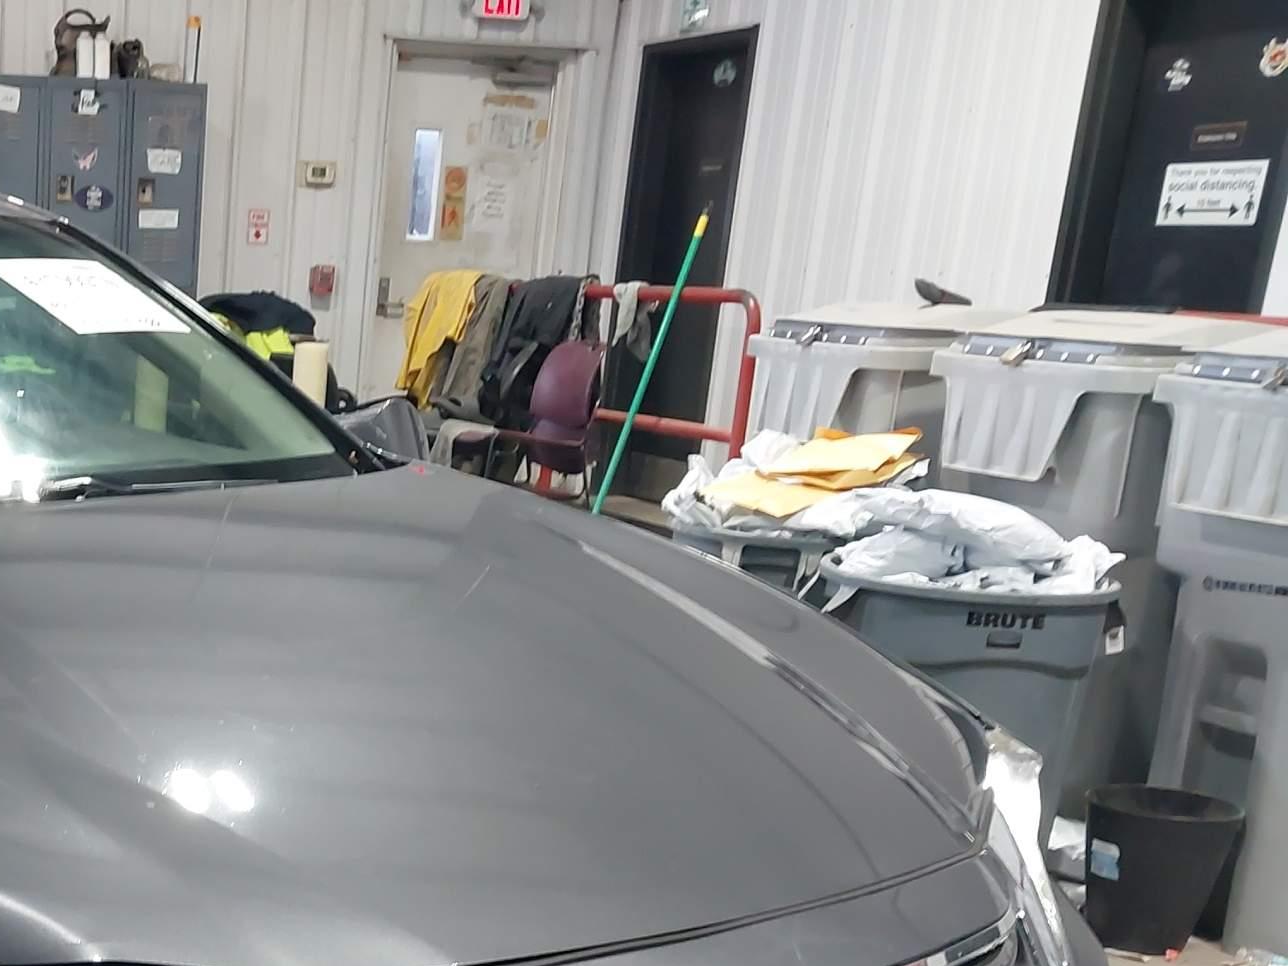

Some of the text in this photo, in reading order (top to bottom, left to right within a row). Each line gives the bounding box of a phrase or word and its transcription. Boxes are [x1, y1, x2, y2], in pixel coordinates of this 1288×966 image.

[1167, 178, 1255, 193] social distancing
[966, 610, 1047, 630] BRUTE
